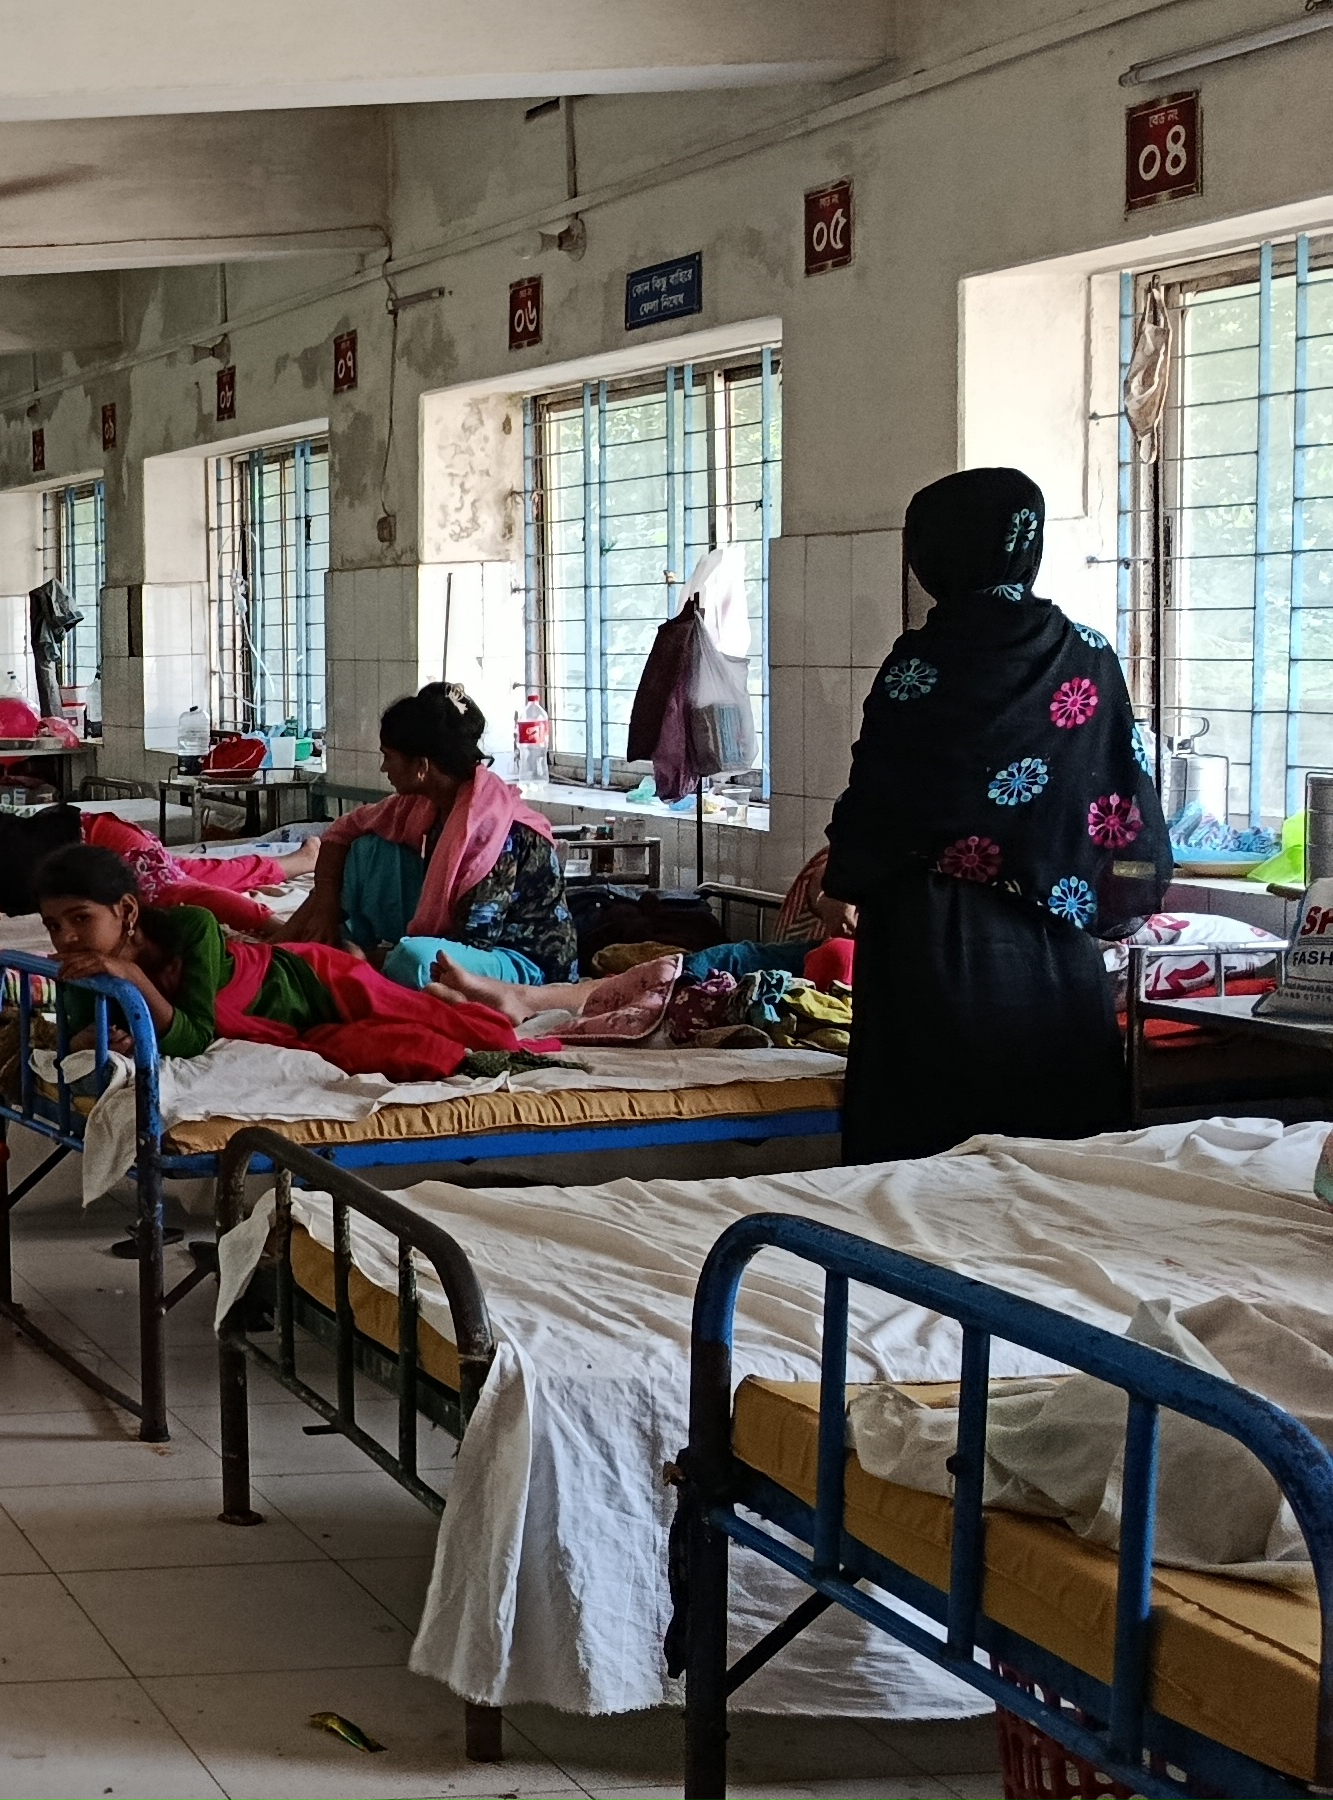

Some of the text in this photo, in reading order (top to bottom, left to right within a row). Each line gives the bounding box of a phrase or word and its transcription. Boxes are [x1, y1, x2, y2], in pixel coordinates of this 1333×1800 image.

[1138, 124, 1187, 181] ০৪
[813, 208, 848, 252] ০৫
[514, 300, 537, 333] ০৬
[639, 298, 659, 316] ফেলা
